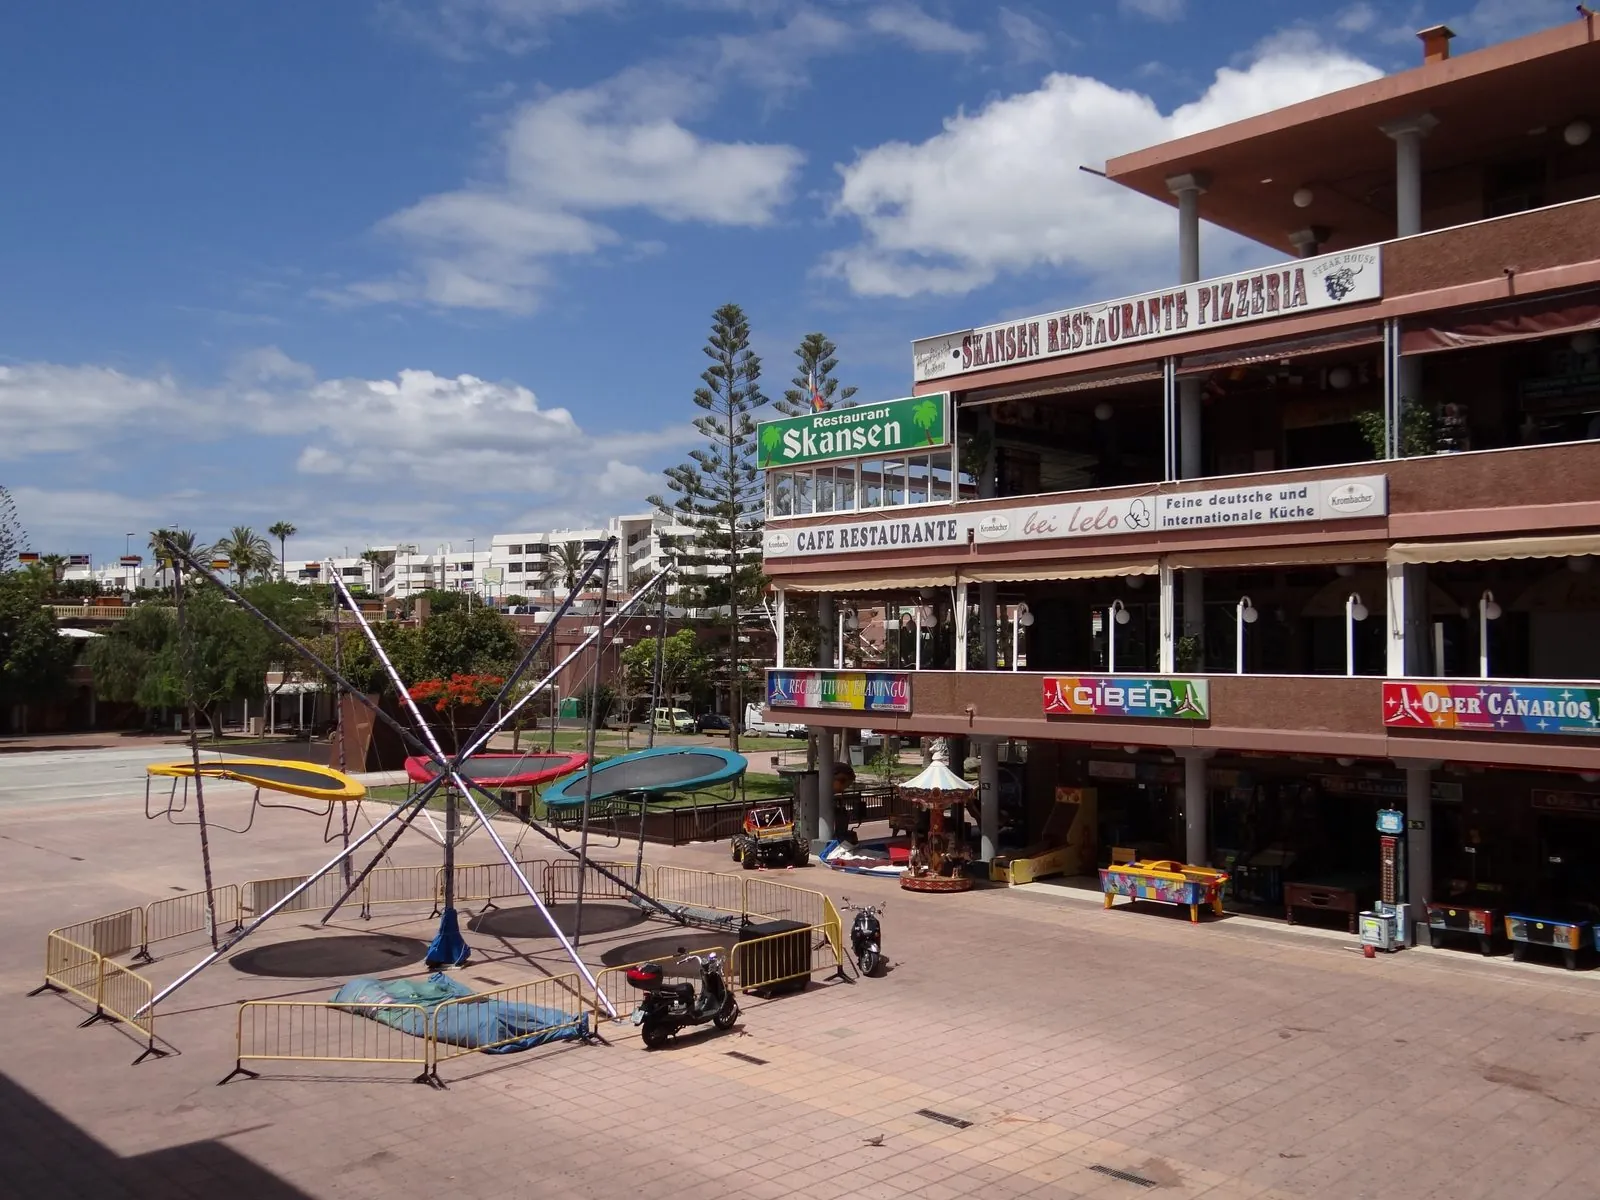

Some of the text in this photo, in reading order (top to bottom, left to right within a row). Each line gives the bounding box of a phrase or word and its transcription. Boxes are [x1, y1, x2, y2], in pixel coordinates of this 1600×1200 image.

[1312, 254, 1376, 277] STEAK HOUSE
[962, 322, 1040, 370] SKANSEN
[1047, 289, 1188, 353] RESTAURANTE
[1198, 268, 1309, 325] PIZZERIA
[813, 407, 891, 428] Restaurant
[782, 420, 901, 459] Skansen
[1166, 487, 1307, 509] Feine deutsche und
[1331, 493, 1373, 506] Krombacher
[1023, 506, 1119, 535] bei Lelo
[1162, 505, 1315, 526] internationale Küche
[796, 519, 958, 552] CAFE RESTAURANTE
[980, 523, 1008, 533] Krombacher
[853, 676, 907, 698] FLAMINGO
[1073, 686, 1173, 708] CIBER
[1422, 691, 1482, 713] OPER
[1487, 692, 1592, 720] CANARIOS
